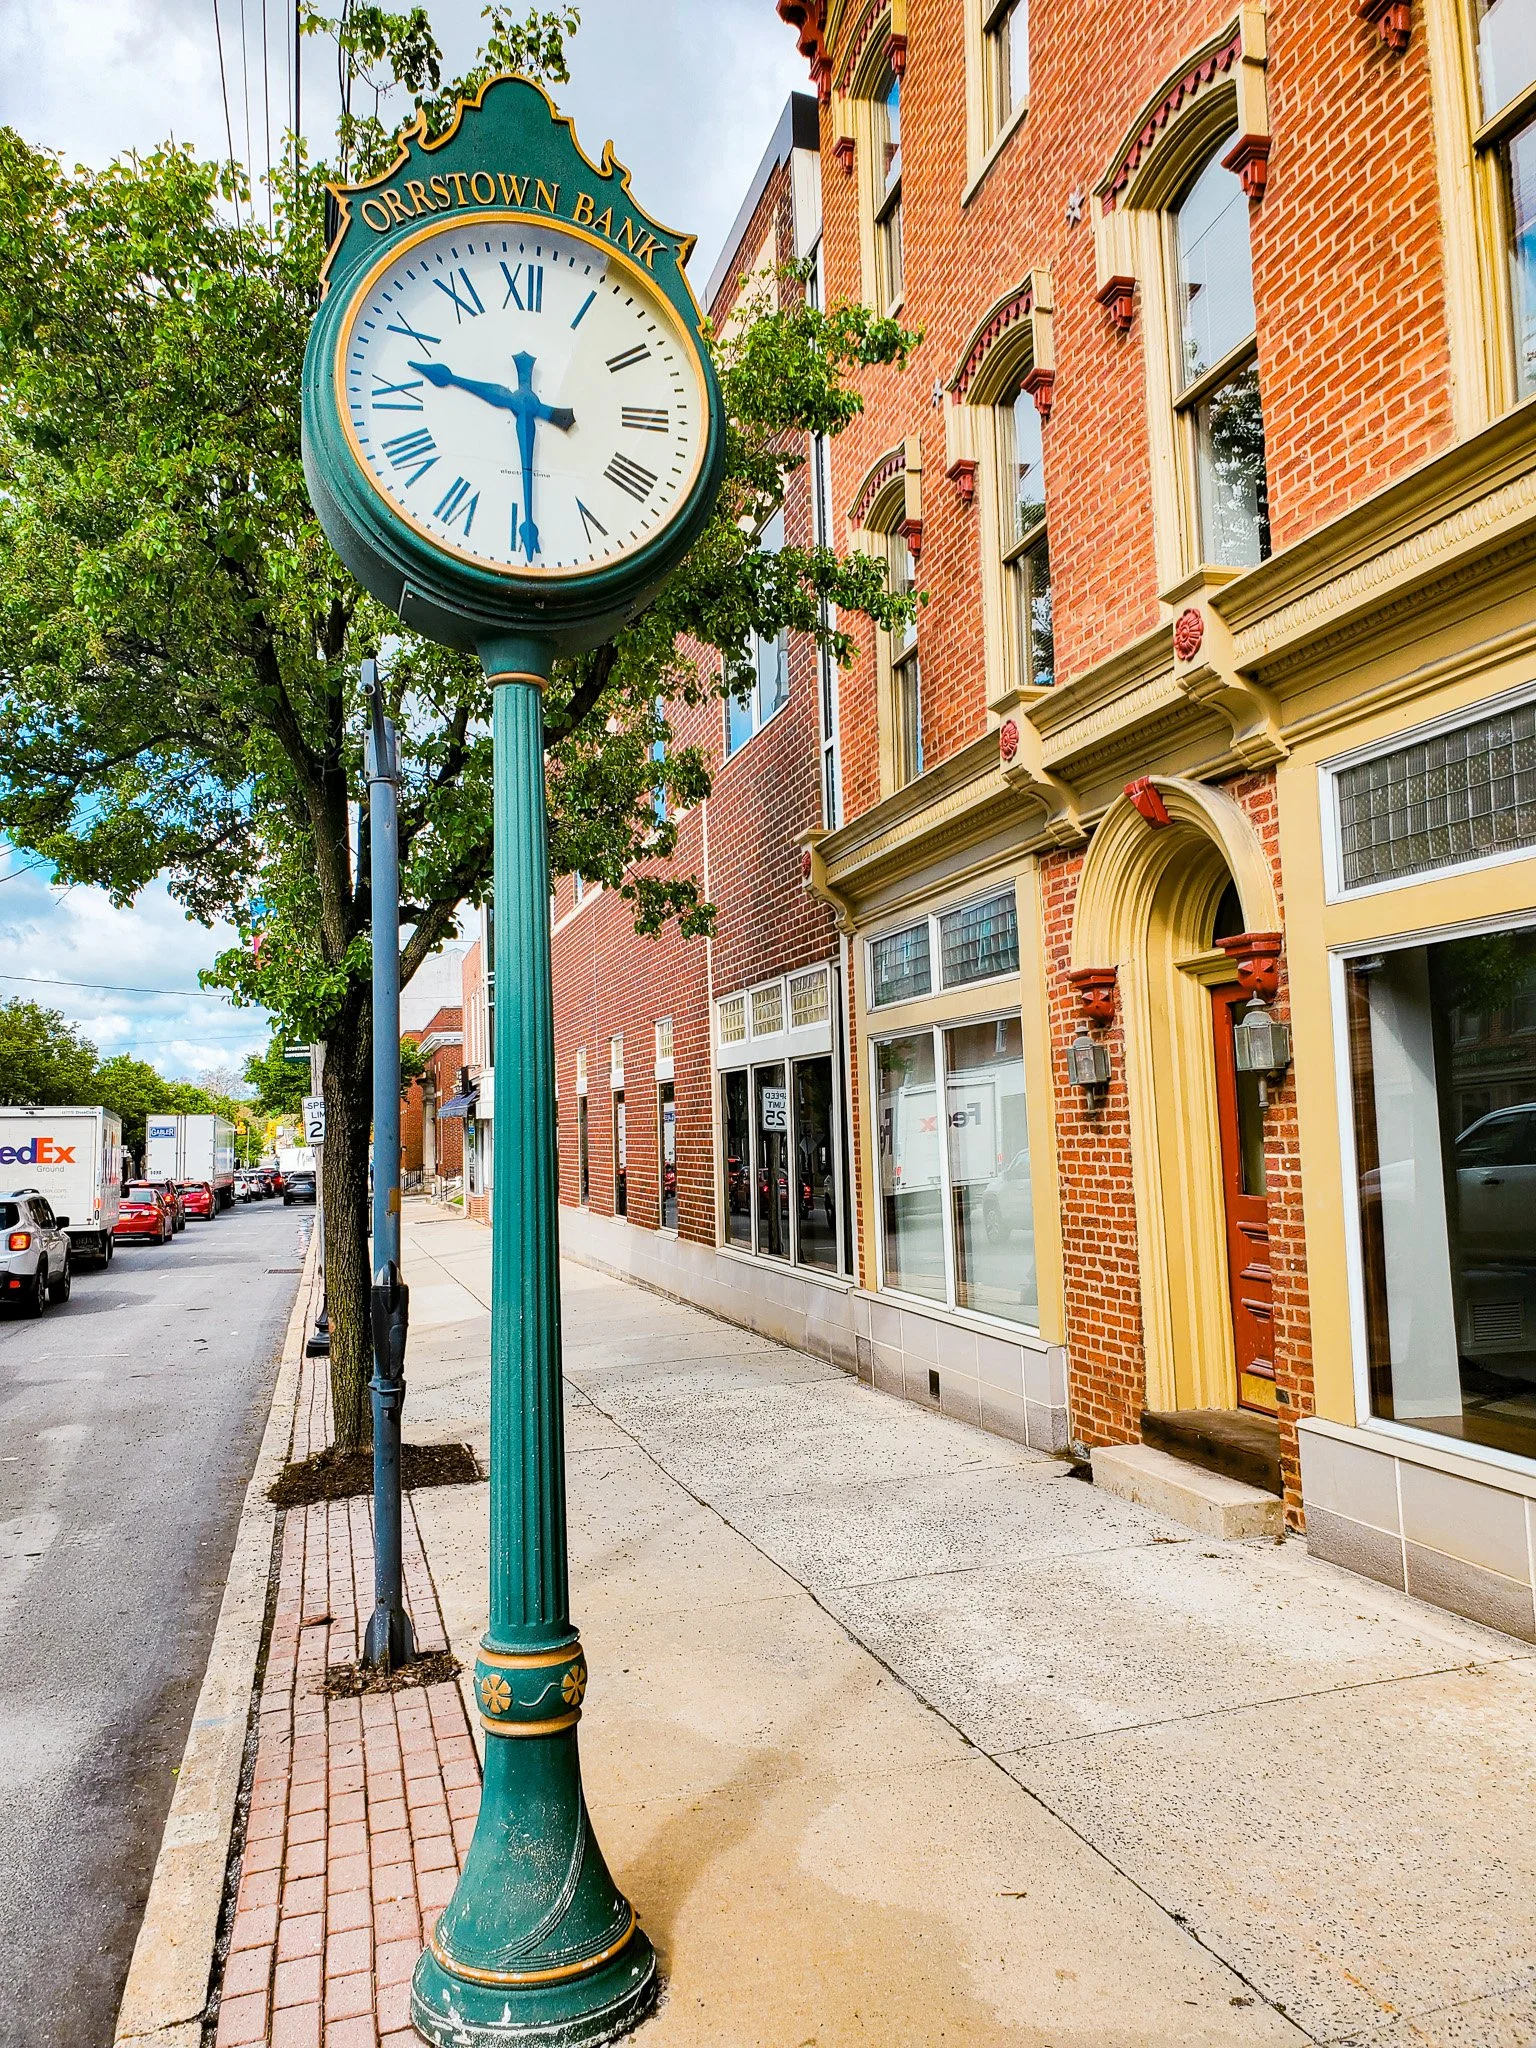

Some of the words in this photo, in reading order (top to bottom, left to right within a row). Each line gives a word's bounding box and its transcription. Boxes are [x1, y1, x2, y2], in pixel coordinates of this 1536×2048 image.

[361, 171, 561, 232] ORRSTOWN
[572, 191, 667, 271] BANK
[433, 266, 486, 325] XI
[500, 260, 544, 313] XII
[386, 311, 441, 358] X
[621, 406, 669, 433] III
[307, 1101, 326, 1110] SPE
[311, 1111, 326, 1119] LIM
[309, 1121, 324, 1138] 2
[0, 1137, 77, 1165] edEx
[36, 1165, 65, 1173] Ground
